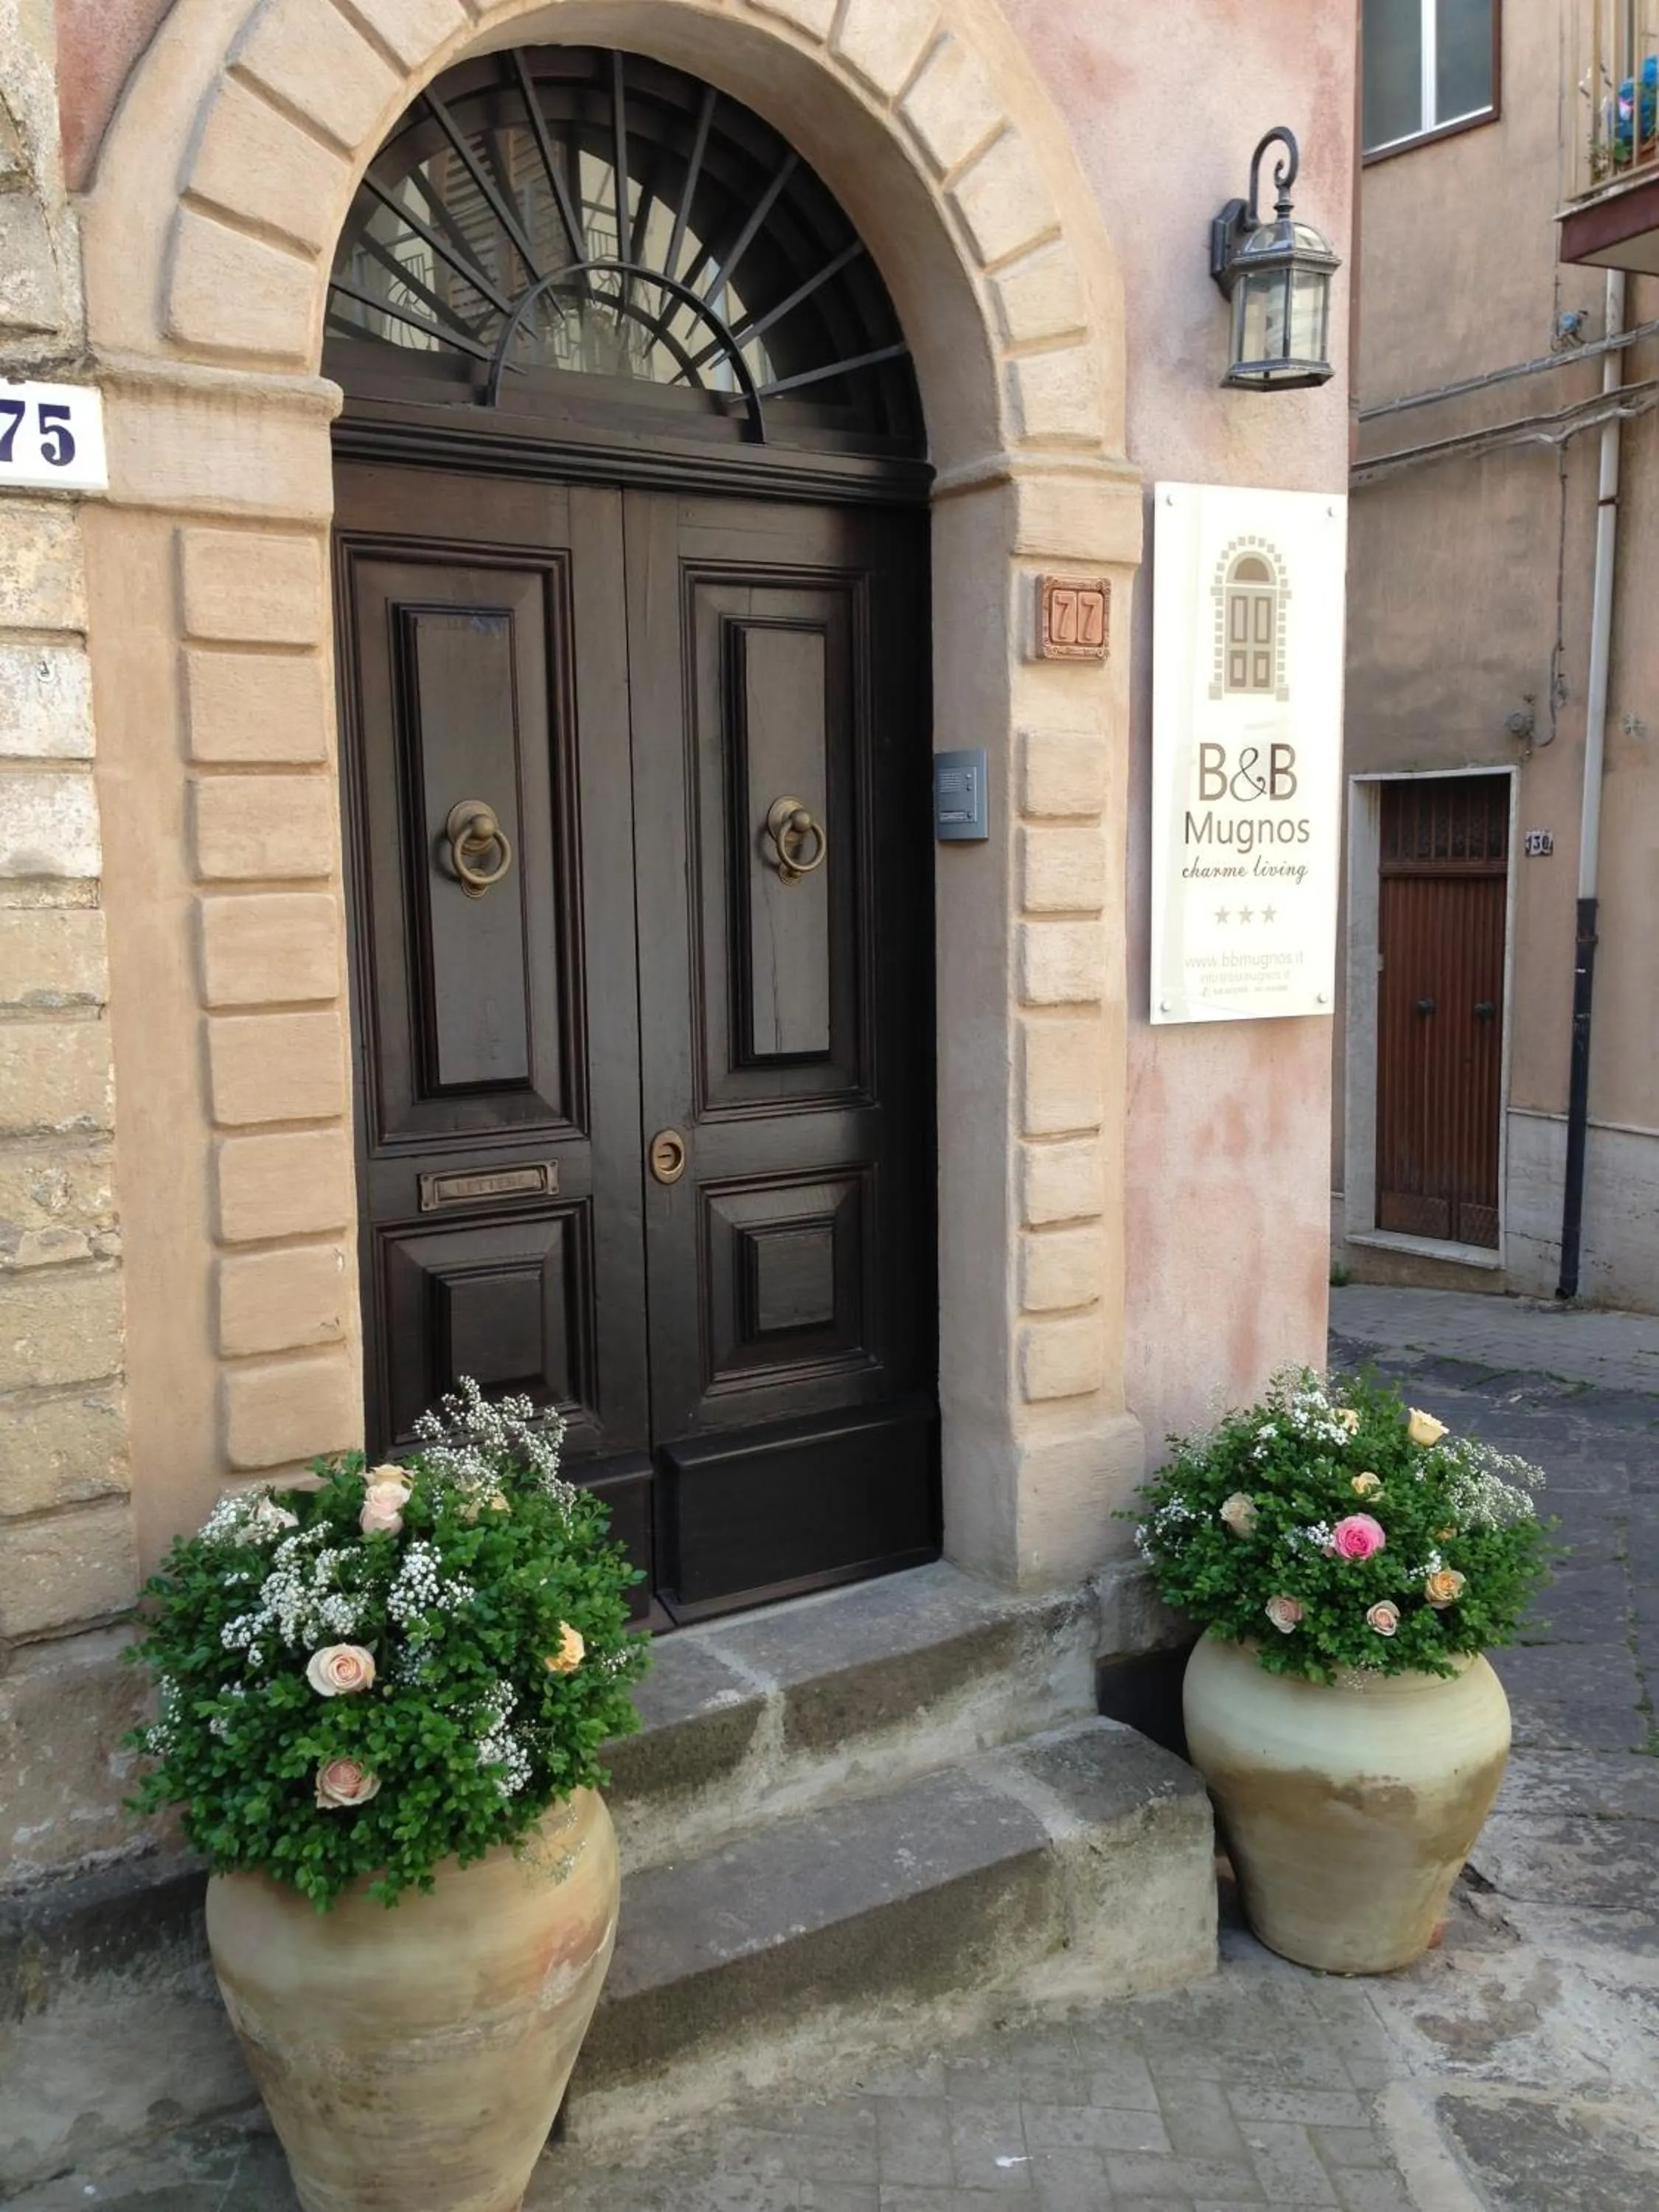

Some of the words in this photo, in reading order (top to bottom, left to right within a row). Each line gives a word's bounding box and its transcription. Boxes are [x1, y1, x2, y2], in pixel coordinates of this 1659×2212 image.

[0, 399, 75, 466] 75
[1055, 592, 1101, 640] 77
[1199, 742, 1297, 802] B&B
[1185, 810, 1310, 854] Mugnos
[1527, 835, 1549, 850] 130
[1182, 855, 1248, 878] charme
[1253, 855, 1309, 885] living
